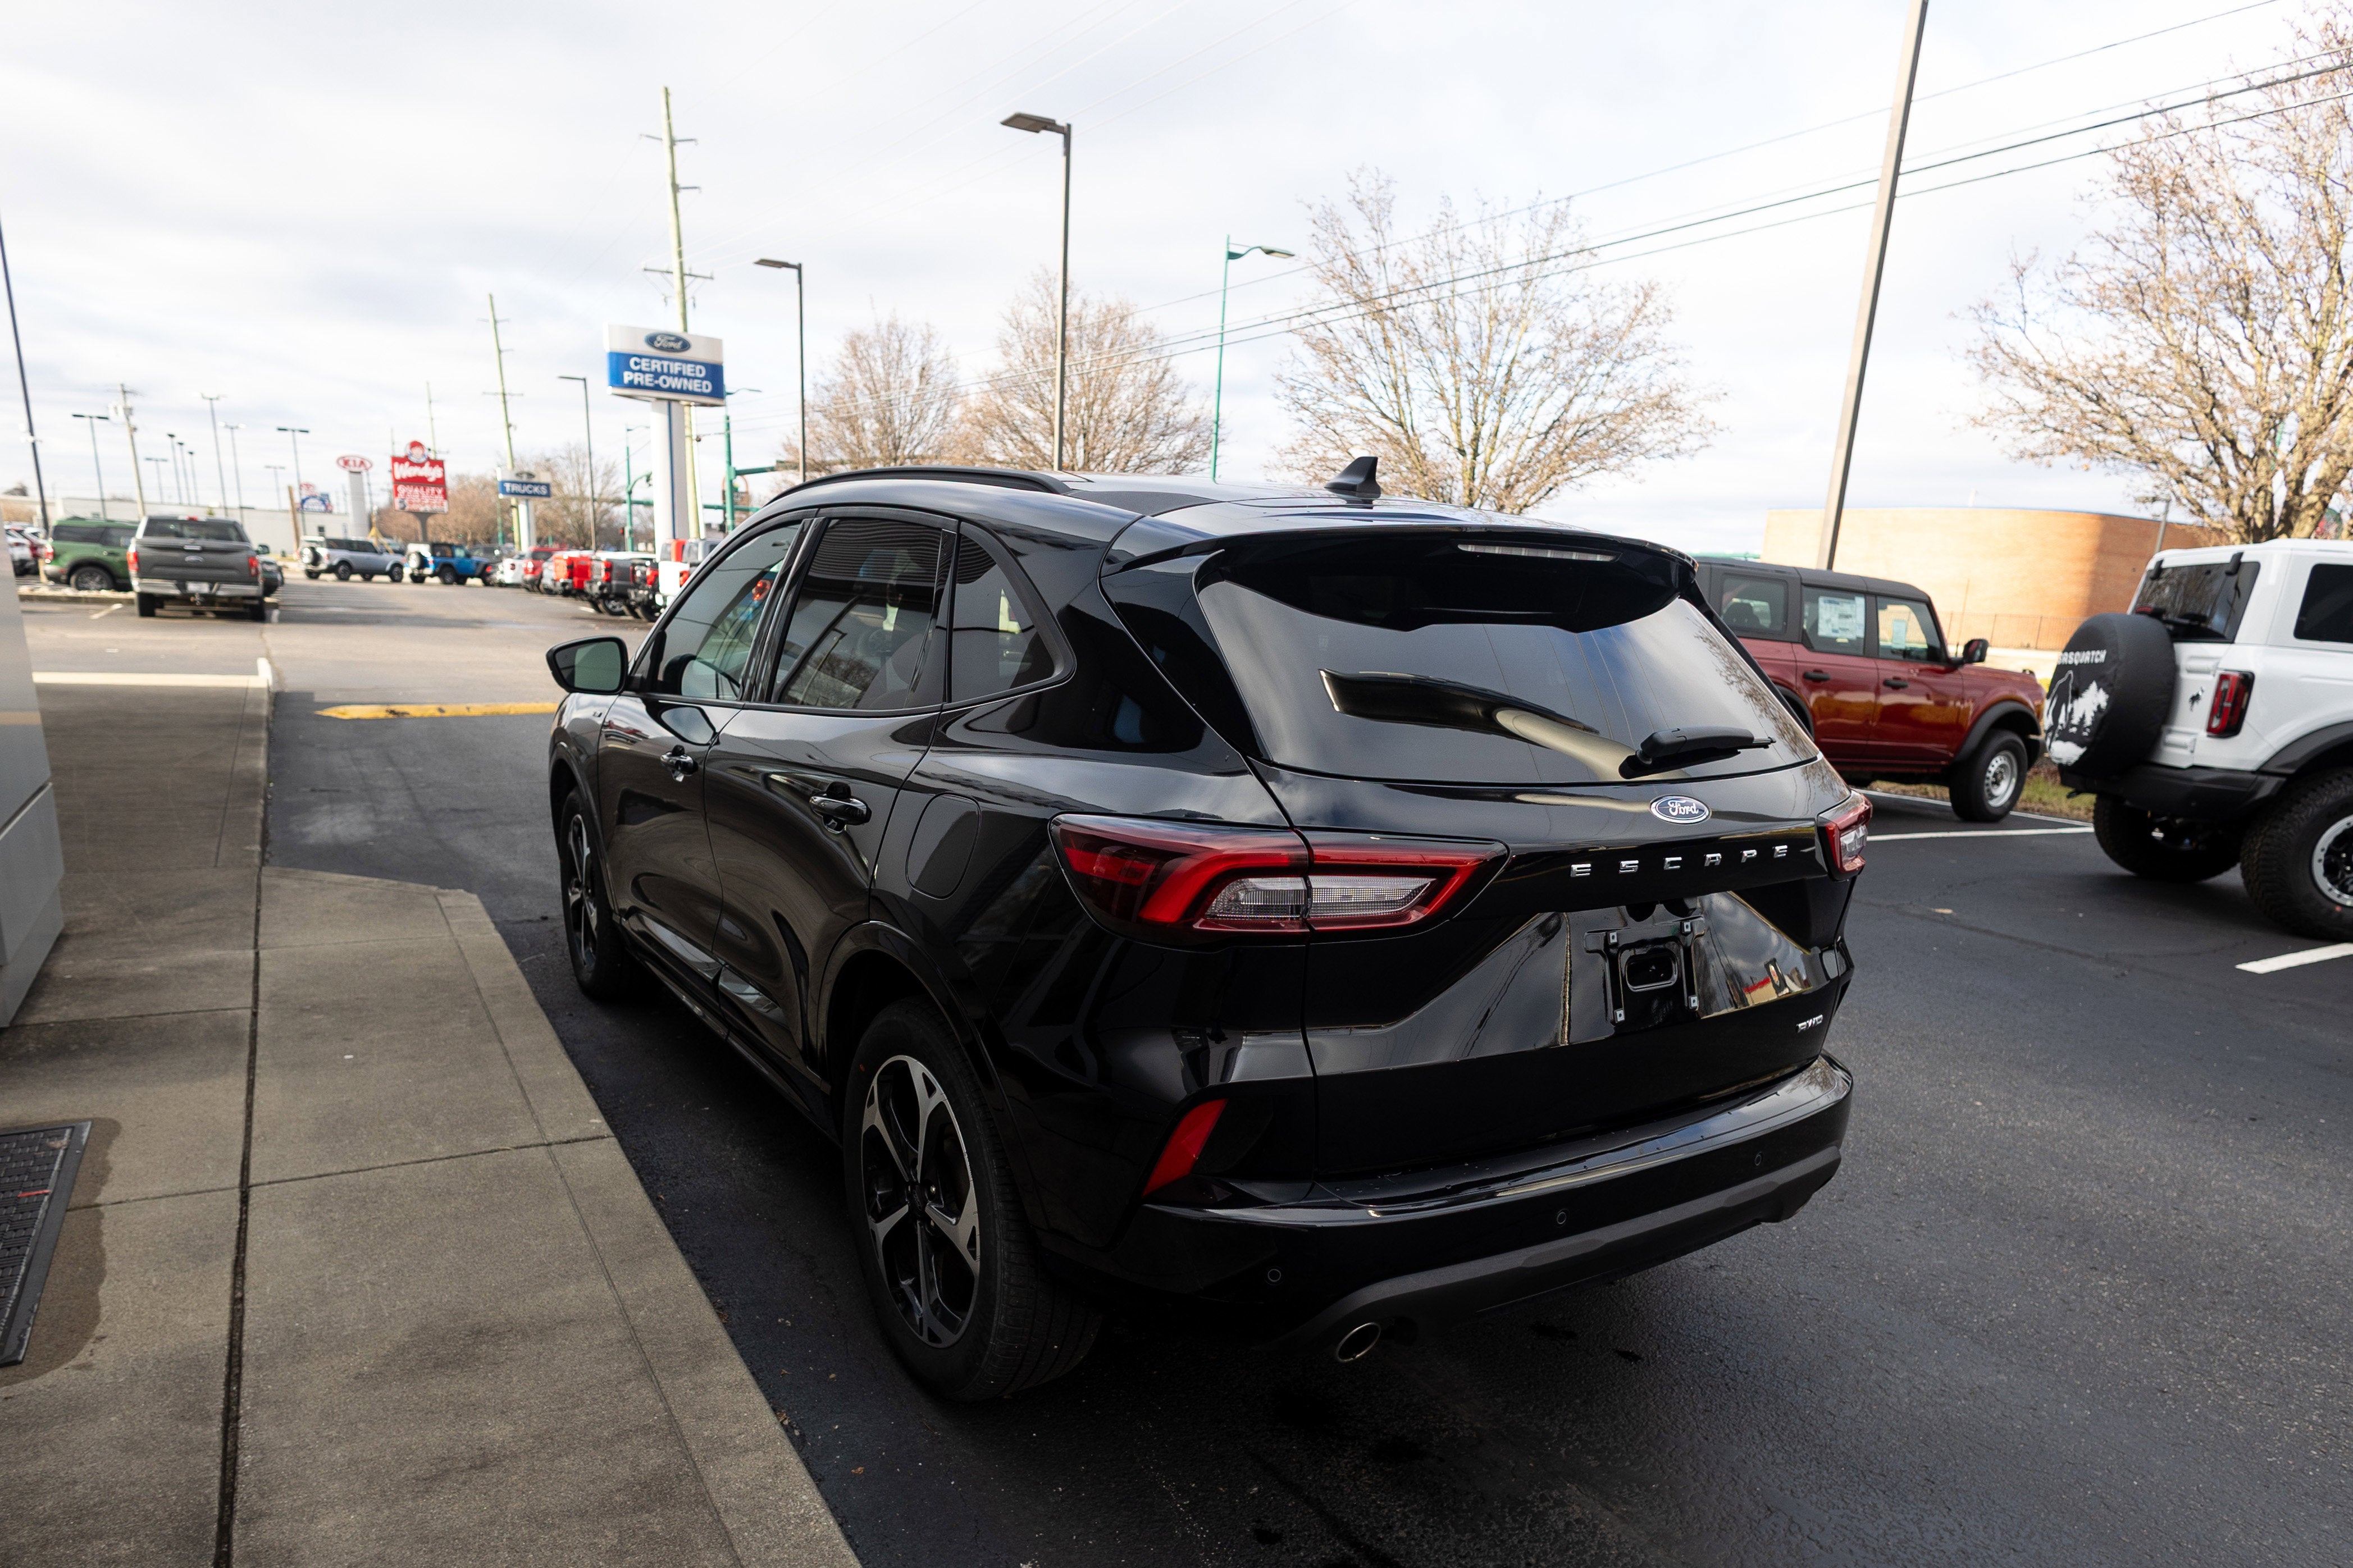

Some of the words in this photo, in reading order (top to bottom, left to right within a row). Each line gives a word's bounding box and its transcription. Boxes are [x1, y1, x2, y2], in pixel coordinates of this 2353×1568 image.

[653, 334, 683, 350] Ford
[629, 356, 706, 378] CERTIFIED
[623, 371, 713, 393] PRE-OWNED
[342, 459, 367, 468] KIA
[394, 461, 444, 482] Wendy's
[396, 484, 442, 496] QUALITY
[503, 482, 548, 495] TRUCKS
[1667, 801, 1699, 816] Ford
[1570, 844, 1788, 877] ESCAPE
[1796, 1014, 1823, 1033] AWD
